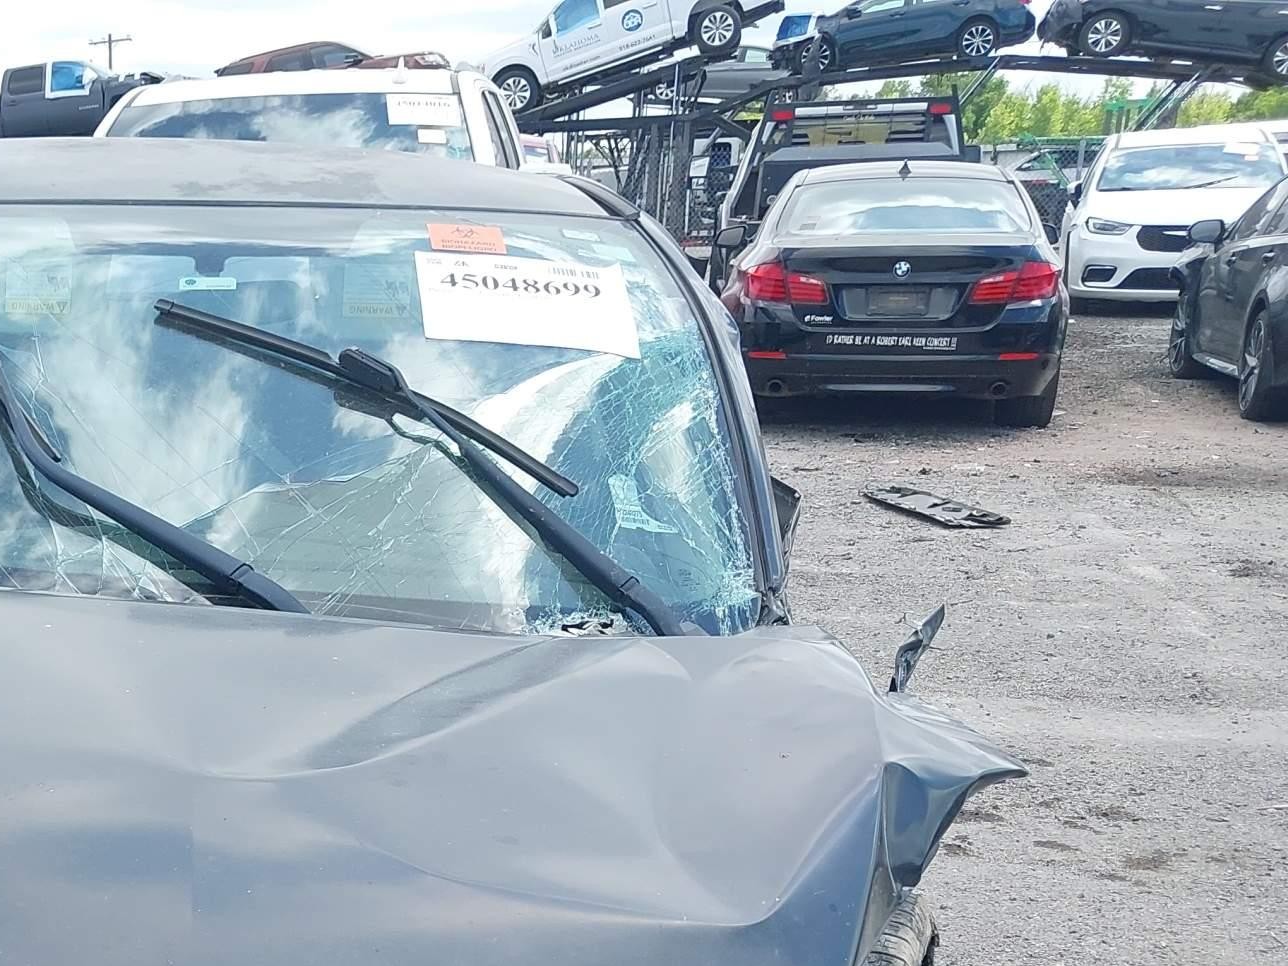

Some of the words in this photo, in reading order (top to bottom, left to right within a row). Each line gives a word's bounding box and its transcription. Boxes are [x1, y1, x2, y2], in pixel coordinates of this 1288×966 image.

[440, 272, 601, 298] 45048699
[863, 336, 870, 344] AT
[927, 337, 950, 347] CONCERT
